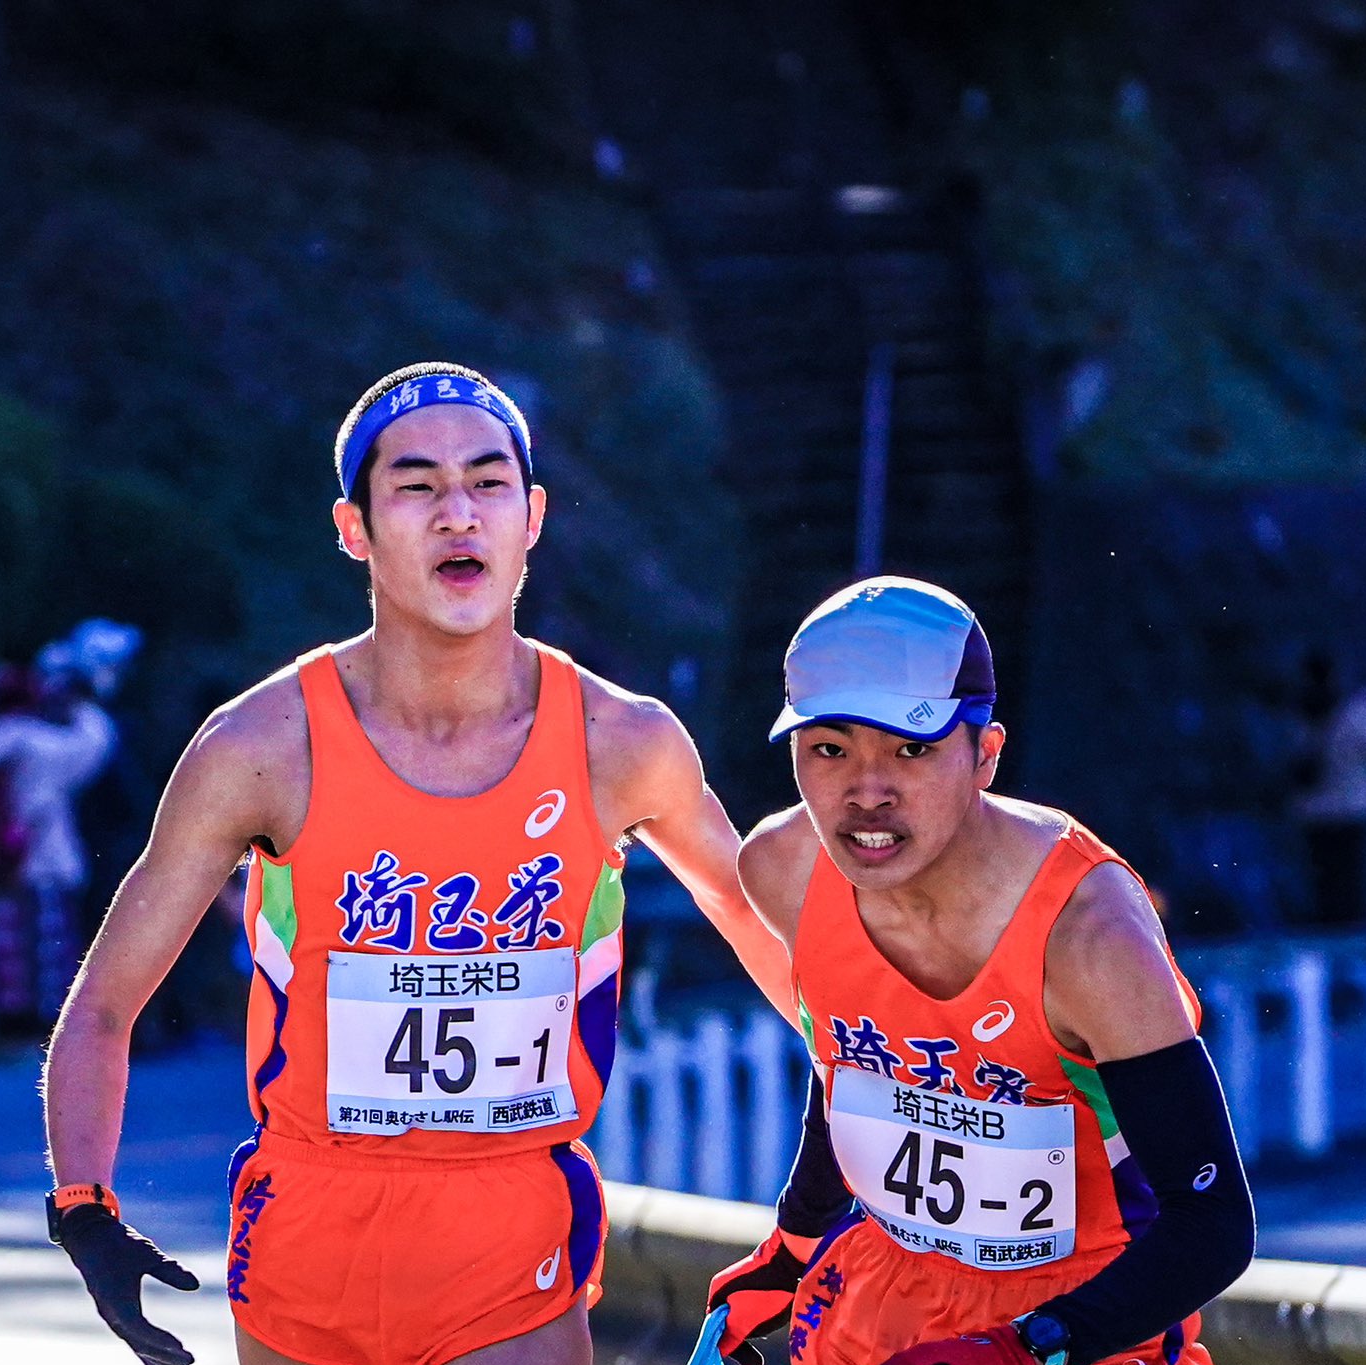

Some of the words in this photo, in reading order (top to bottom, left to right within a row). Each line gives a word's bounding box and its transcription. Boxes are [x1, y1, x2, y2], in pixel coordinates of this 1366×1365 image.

[335, 850, 565, 952] 埼玉栄
[389, 962, 521, 998] 埼玉栄B
[384, 1007, 551, 1094] 45-1
[339, 1106, 474, 1126] 第21回奥むさし駅伝
[492, 1096, 555, 1125] 西武鉄道
[893, 1086, 1005, 1140] 埼玉栄B
[883, 1131, 1054, 1231] 45-2
[978, 1241, 1053, 1262] 西武鉄道
